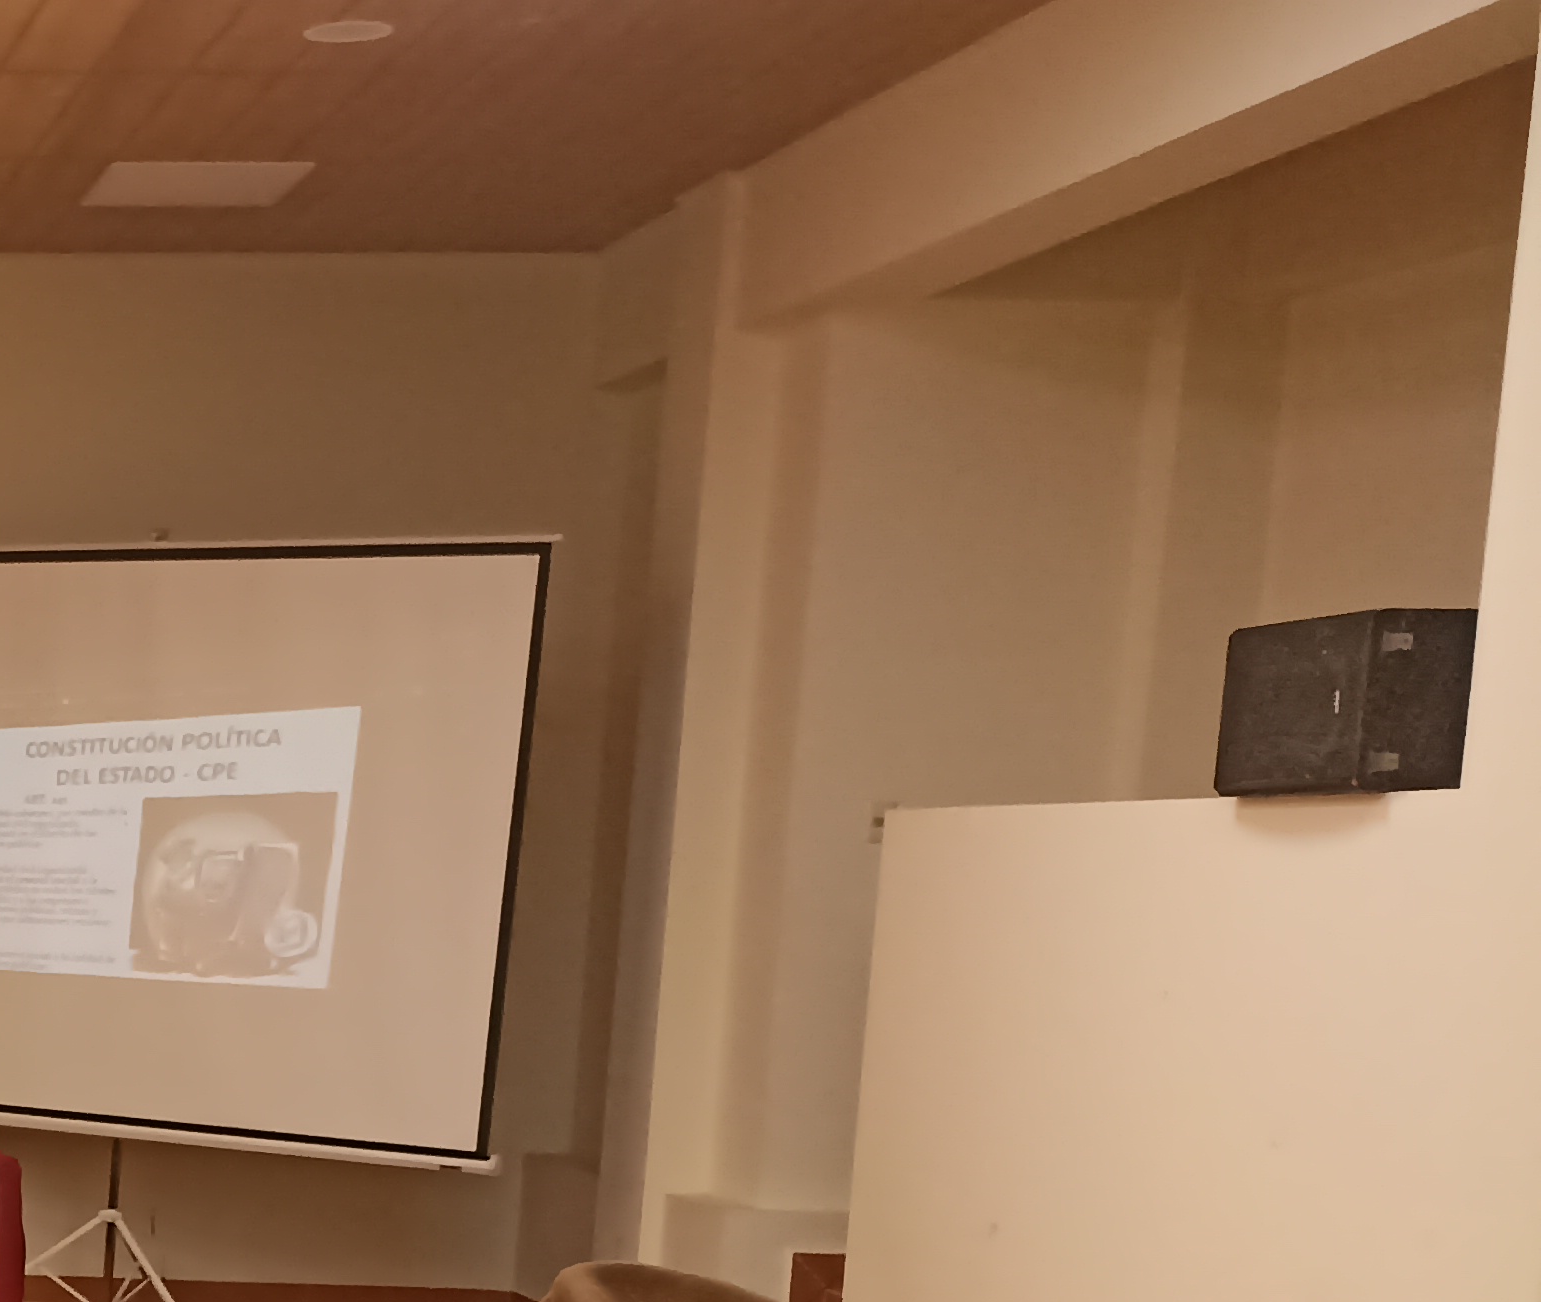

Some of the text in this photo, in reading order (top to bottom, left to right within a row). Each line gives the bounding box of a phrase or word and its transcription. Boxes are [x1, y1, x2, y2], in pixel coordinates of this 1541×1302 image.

[25, 726, 282, 759] CONSTITUCIÓN POLÍTICA
[56, 768, 91, 786] DEL
[98, 765, 175, 785] ESTADO
[196, 761, 238, 782] CPE
